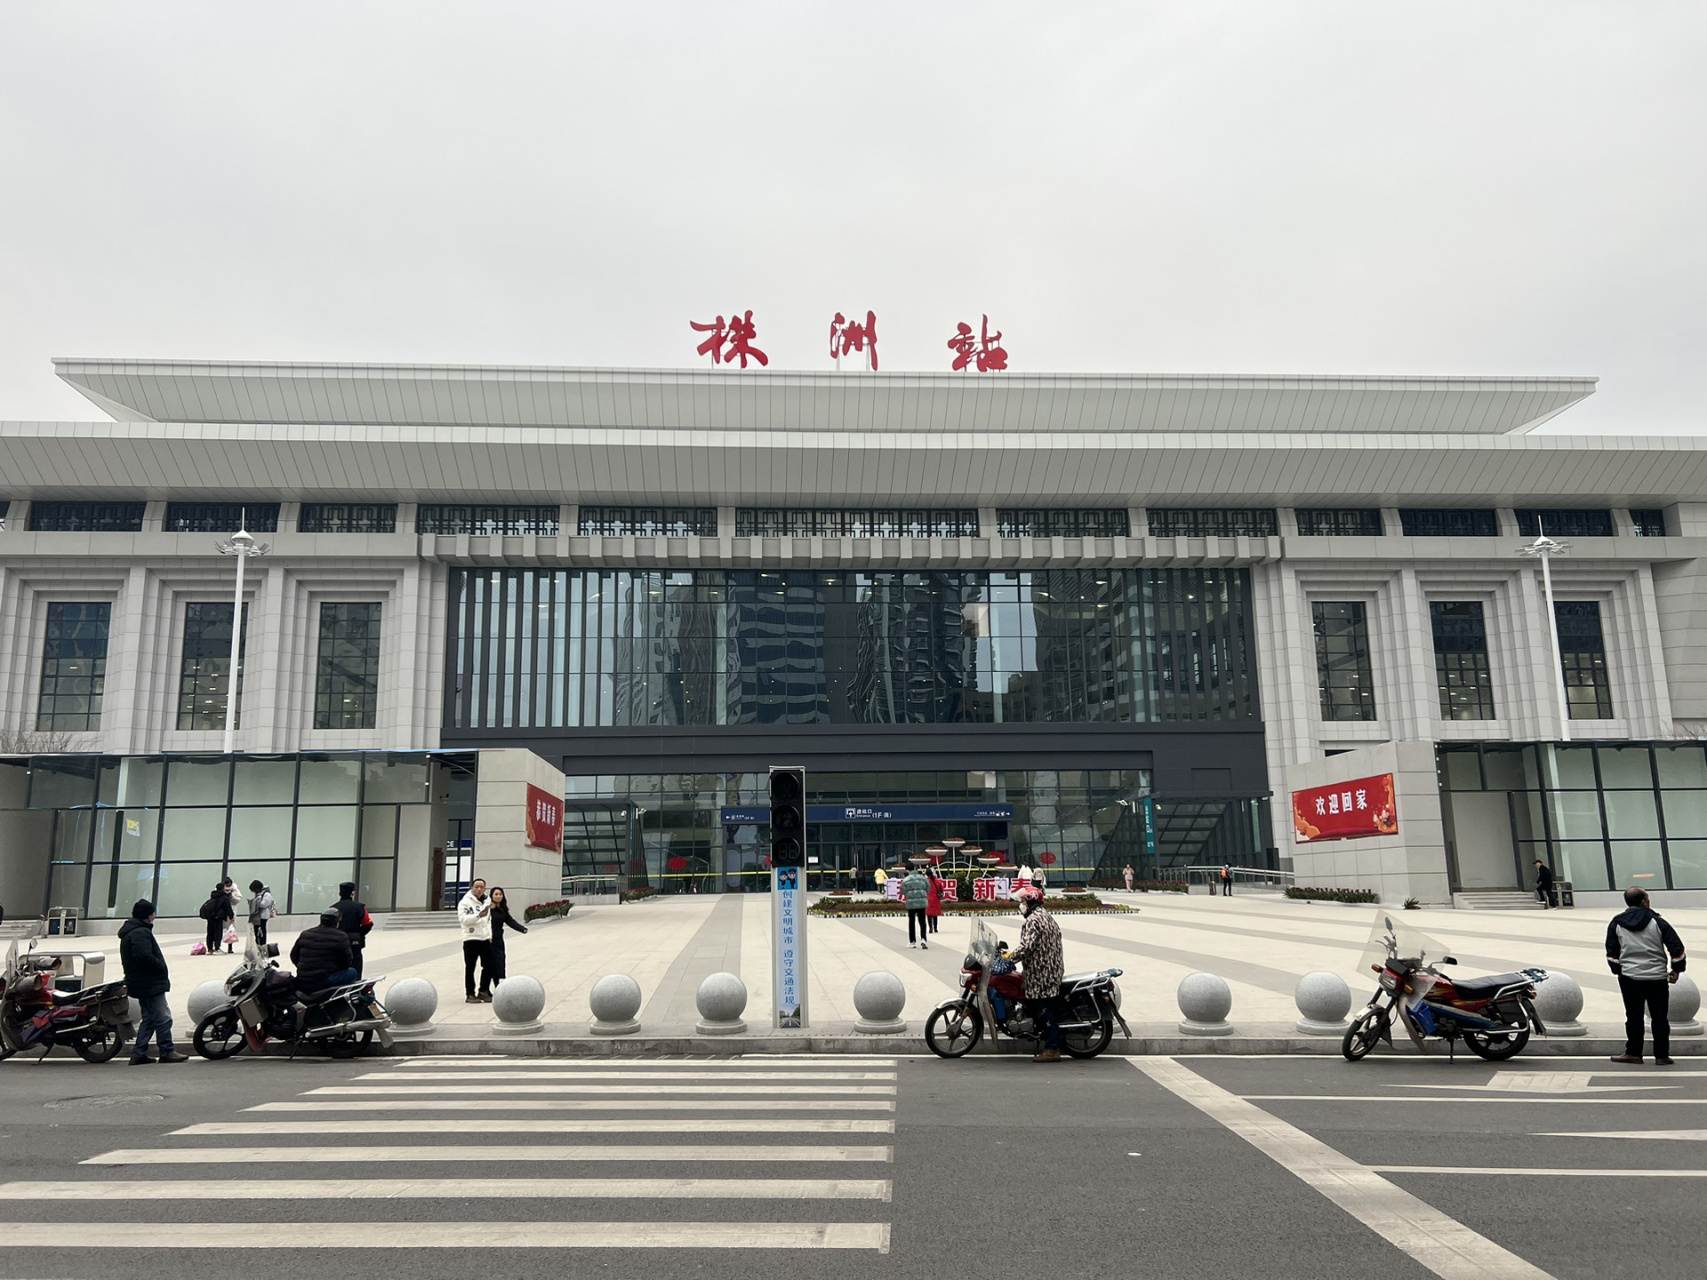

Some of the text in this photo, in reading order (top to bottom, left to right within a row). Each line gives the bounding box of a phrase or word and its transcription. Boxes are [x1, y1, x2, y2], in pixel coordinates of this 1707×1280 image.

[689, 309, 1008, 373] 株洲站
[1315, 788, 1368, 816] 欢迎回家
[783, 891, 795, 1005] 创建文明城市 遵守交通法规
